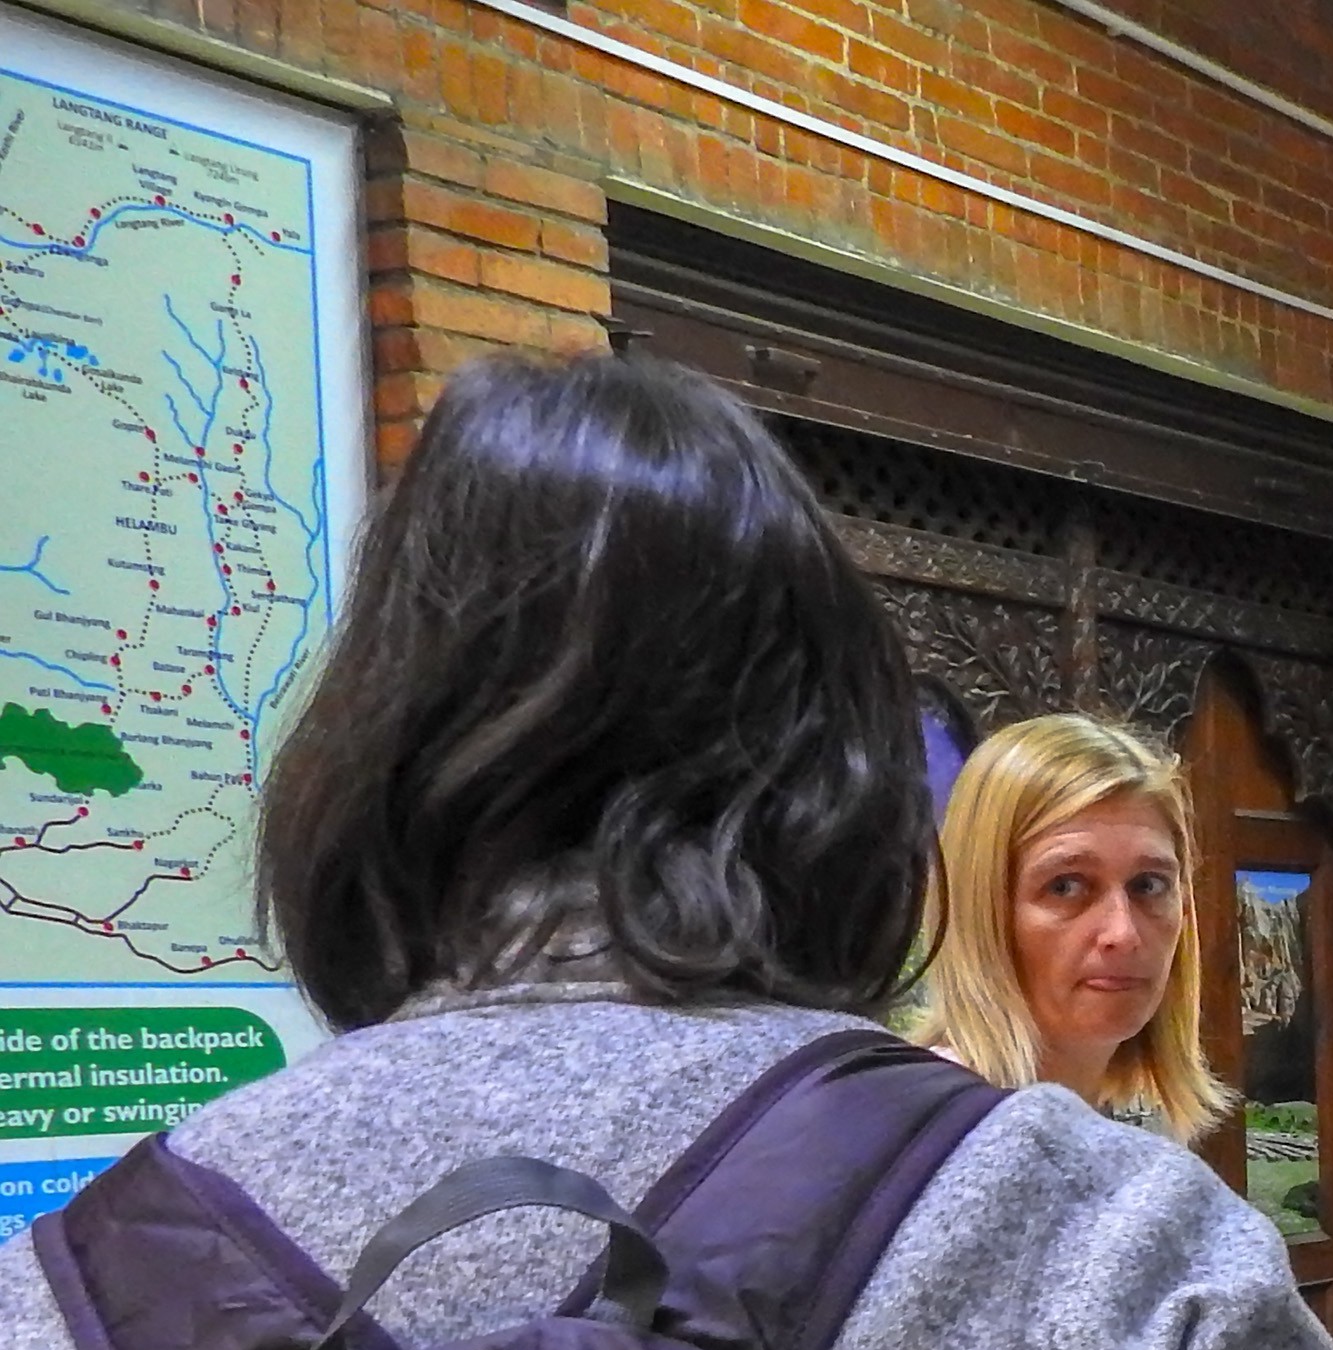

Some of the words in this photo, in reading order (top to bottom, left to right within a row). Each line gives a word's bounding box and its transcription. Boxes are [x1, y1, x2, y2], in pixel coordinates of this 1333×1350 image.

[53, 97, 122, 127] LANGTANG
[125, 118, 167, 140] RANGE
[115, 516, 177, 535] HELAMBU
[51, 1028, 81, 1051] of
[88, 1027, 133, 1050] the
[141, 1025, 264, 1055] backpack
[90, 1061, 229, 1087] insulation.
[63, 1106, 95, 1124] or
